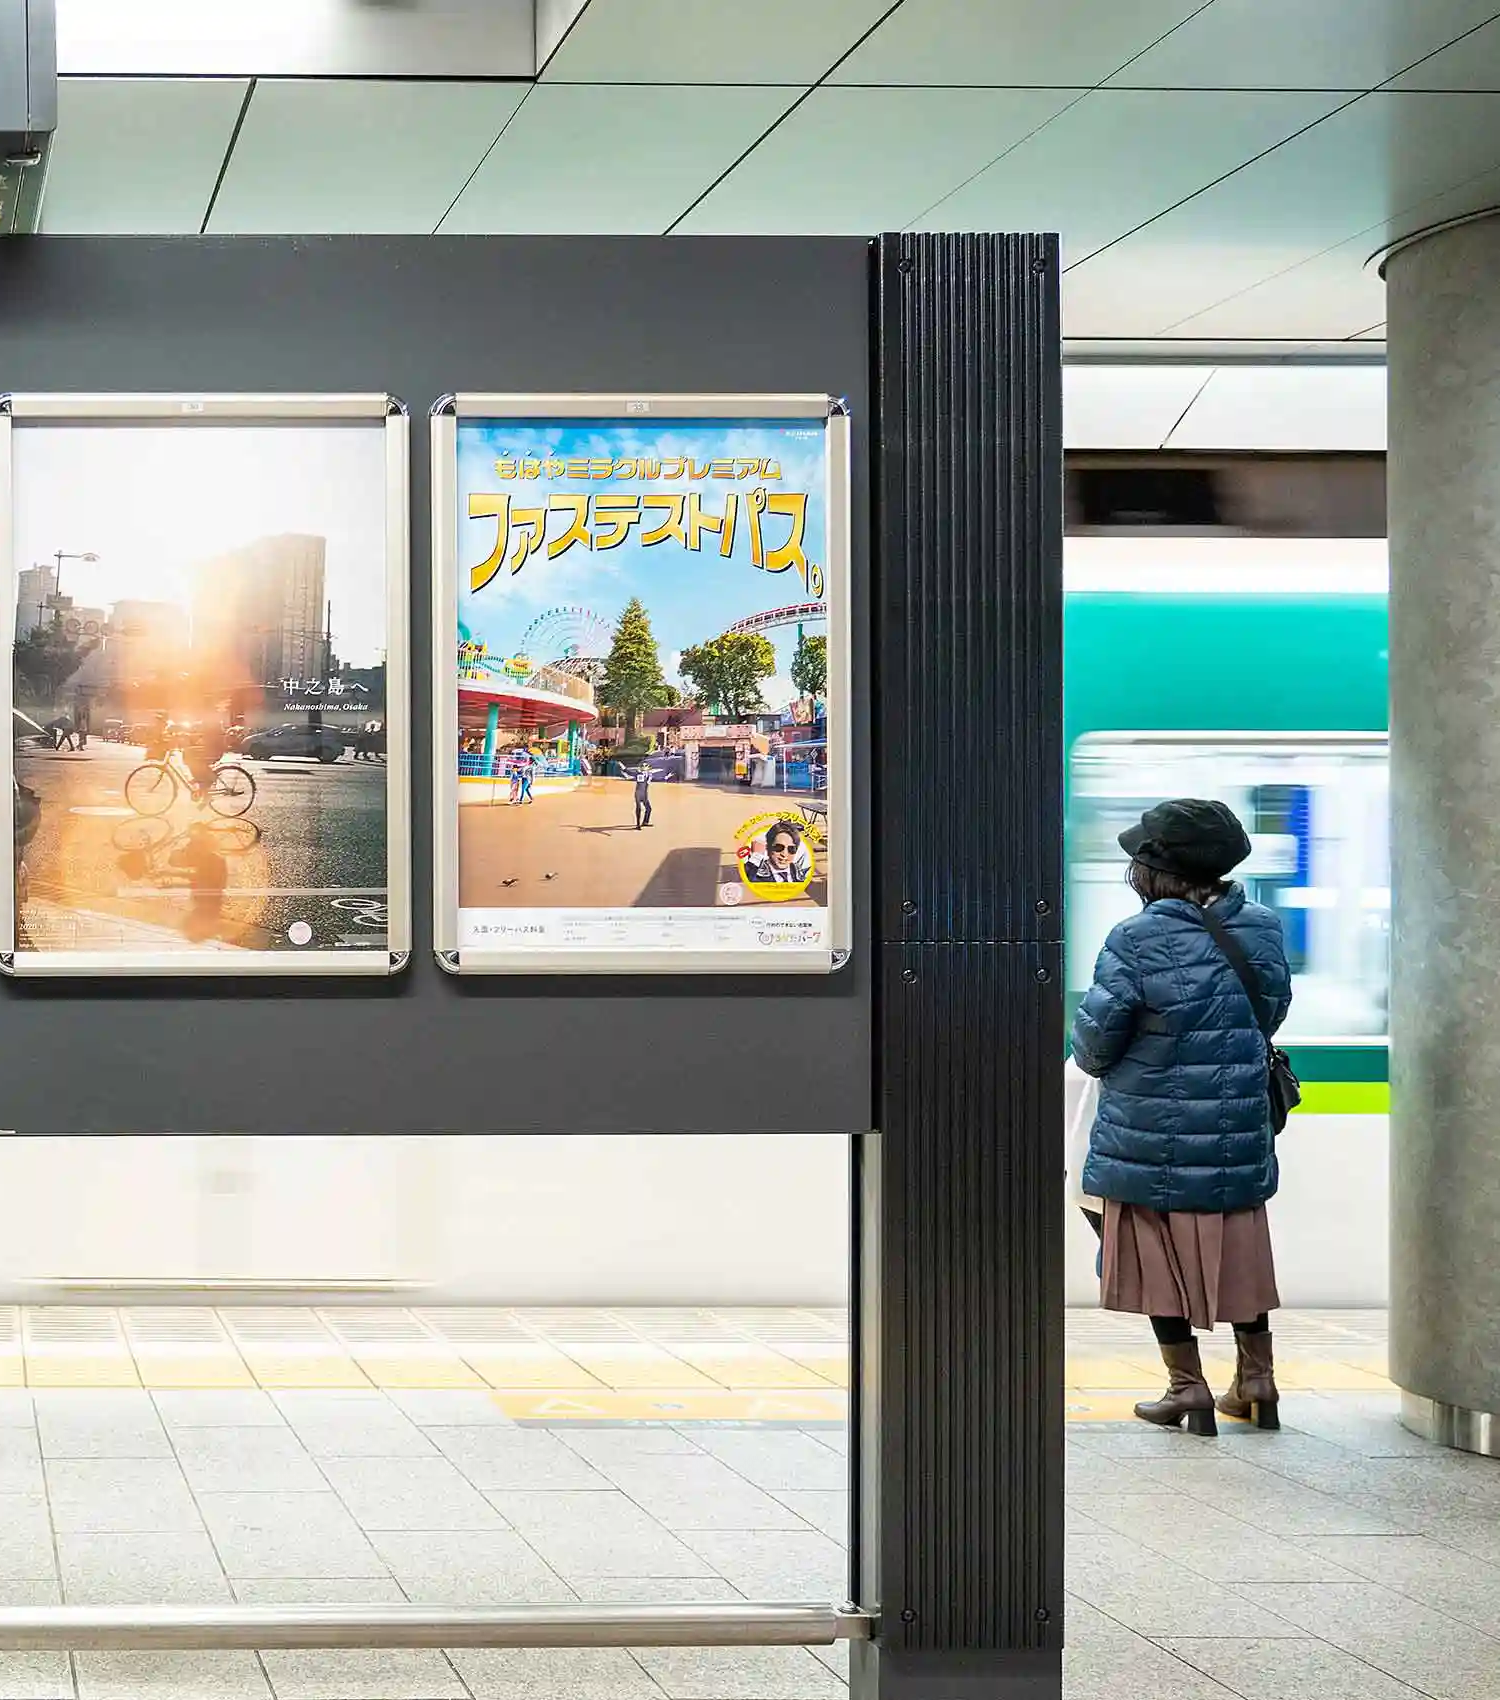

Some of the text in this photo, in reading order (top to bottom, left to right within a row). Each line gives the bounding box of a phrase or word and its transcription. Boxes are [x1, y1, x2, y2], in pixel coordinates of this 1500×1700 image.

[494, 455, 783, 481] もはやミラクルプレミアム
[282, 676, 369, 696] 中之島へ
